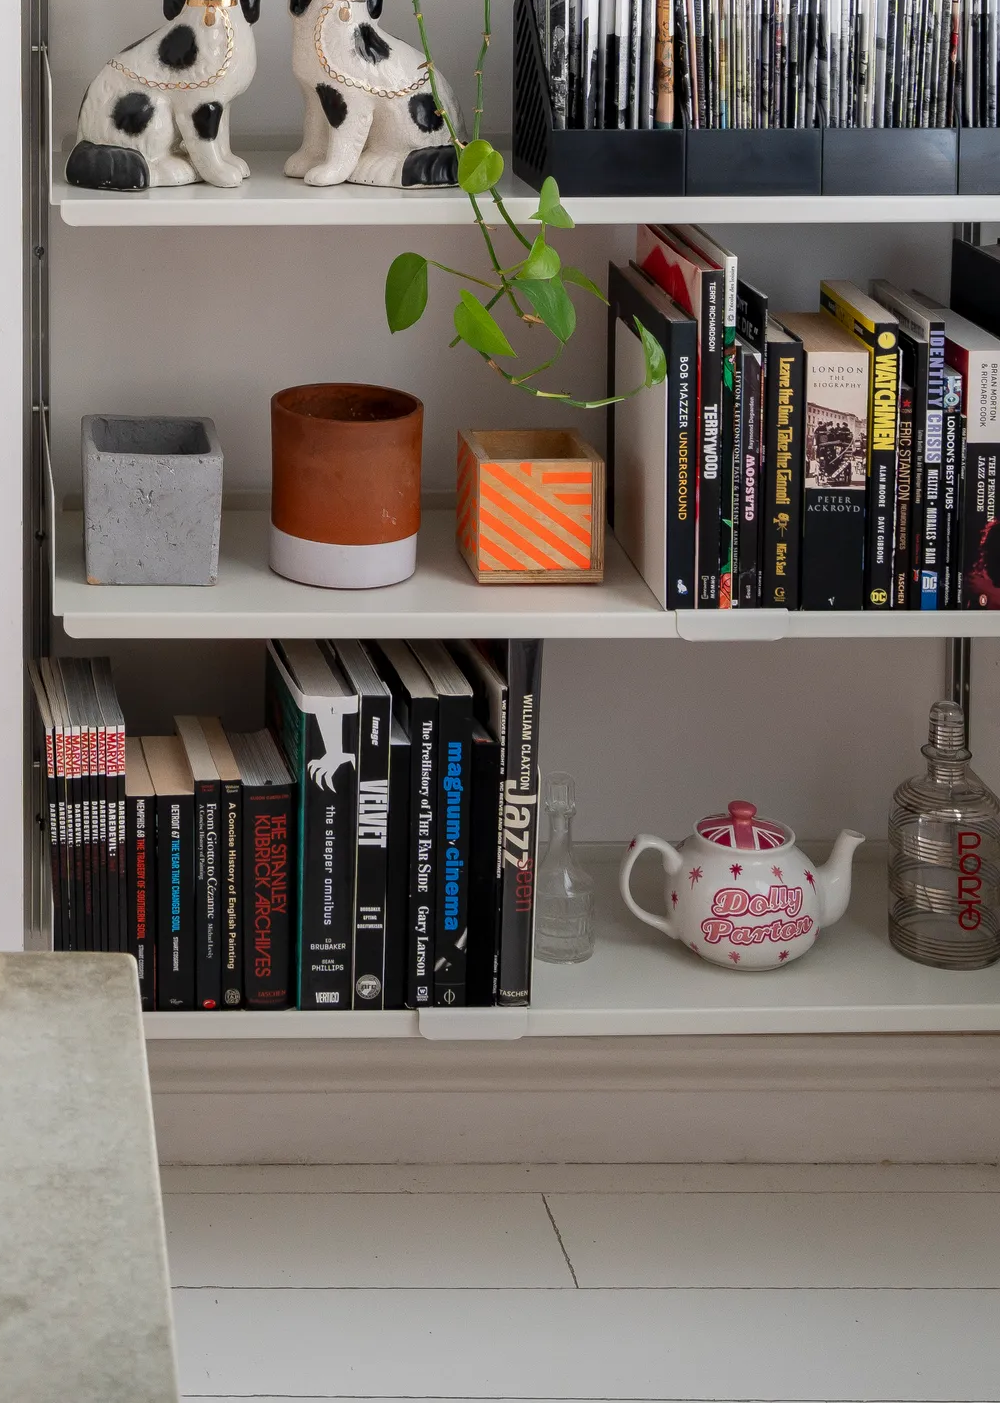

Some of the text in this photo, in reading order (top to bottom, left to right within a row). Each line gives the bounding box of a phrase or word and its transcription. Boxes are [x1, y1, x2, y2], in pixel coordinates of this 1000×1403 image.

[708, 281, 716, 352] TERRY RICHARDSON
[774, 357, 795, 505] Leave the Gun, Take the Cannoli
[872, 353, 898, 450] WATCHMEN
[925, 330, 946, 462] IDENTITY CRISIS
[677, 356, 689, 521] BOB MAZZER UNDERGROUND
[703, 403, 719, 480] TERRYWOOD
[945, 415, 956, 463] LONDON'S
[745, 454, 756, 521] GLASGOW
[877, 465, 887, 508] ALAN MOORE
[944, 487, 955, 510] PUBS
[945, 464, 955, 486] BEST
[976, 455, 986, 512] JAZZ GUIDE
[986, 455, 997, 523] THE PENGUIN
[876, 516, 886, 564] DAVE GIBBONS
[106, 733, 117, 775] MARVEL
[519, 694, 534, 790] WILLIAM CLAXTON
[357, 779, 388, 848] VELVET
[442, 741, 465, 931] magnum cinema
[502, 779, 537, 871] Jazz
[254, 814, 271, 978] KUBRICK ARCHIVES
[271, 813, 287, 914] THE STANLEY
[323, 805, 336, 926] the sleeper omnibus
[702, 916, 813, 945] Parton
[713, 886, 803, 916] Dolly
